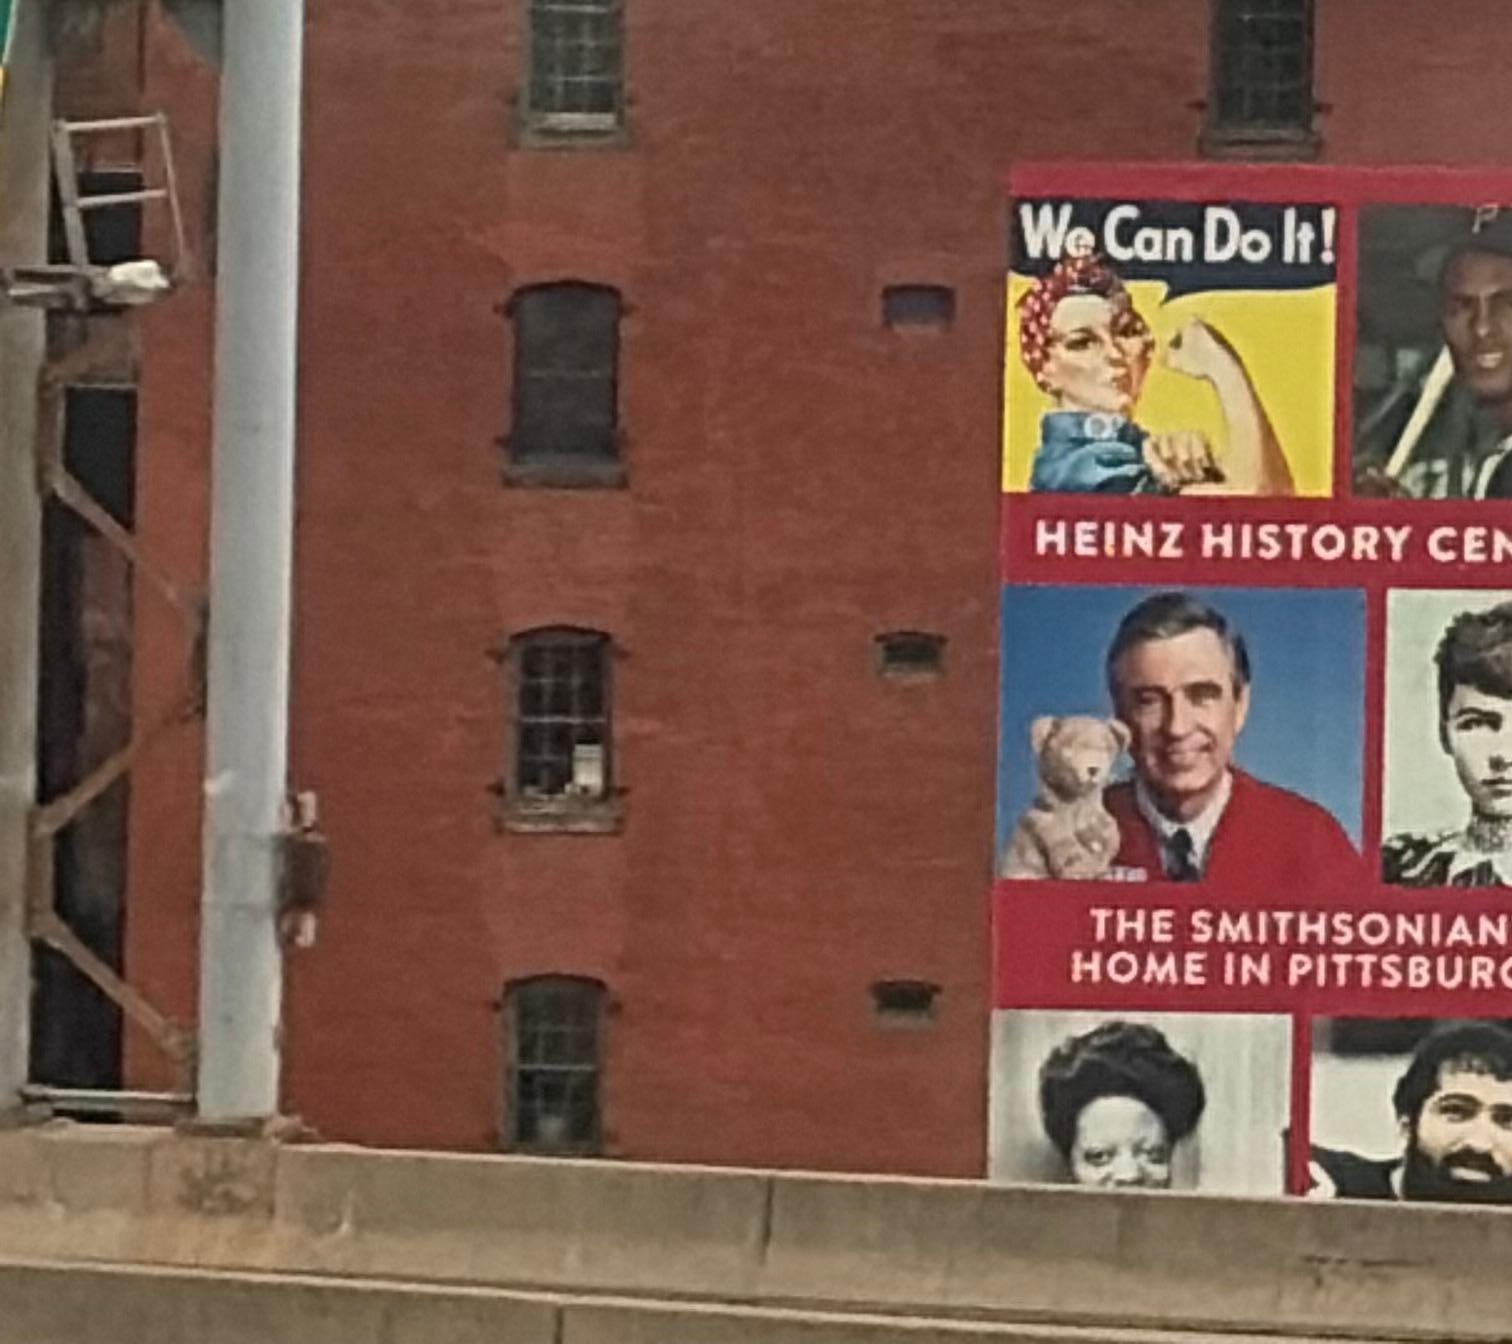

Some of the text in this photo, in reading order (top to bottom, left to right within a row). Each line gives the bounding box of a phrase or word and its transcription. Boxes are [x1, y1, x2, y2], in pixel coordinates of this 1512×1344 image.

[1019, 202, 1337, 265] We Can Do It!
[1036, 519, 1185, 557] HEINZ
[1201, 523, 1413, 561] HISTORY
[1090, 908, 1176, 943] THE
[1071, 950, 1208, 986] HOME
[1224, 951, 1271, 987] IN
